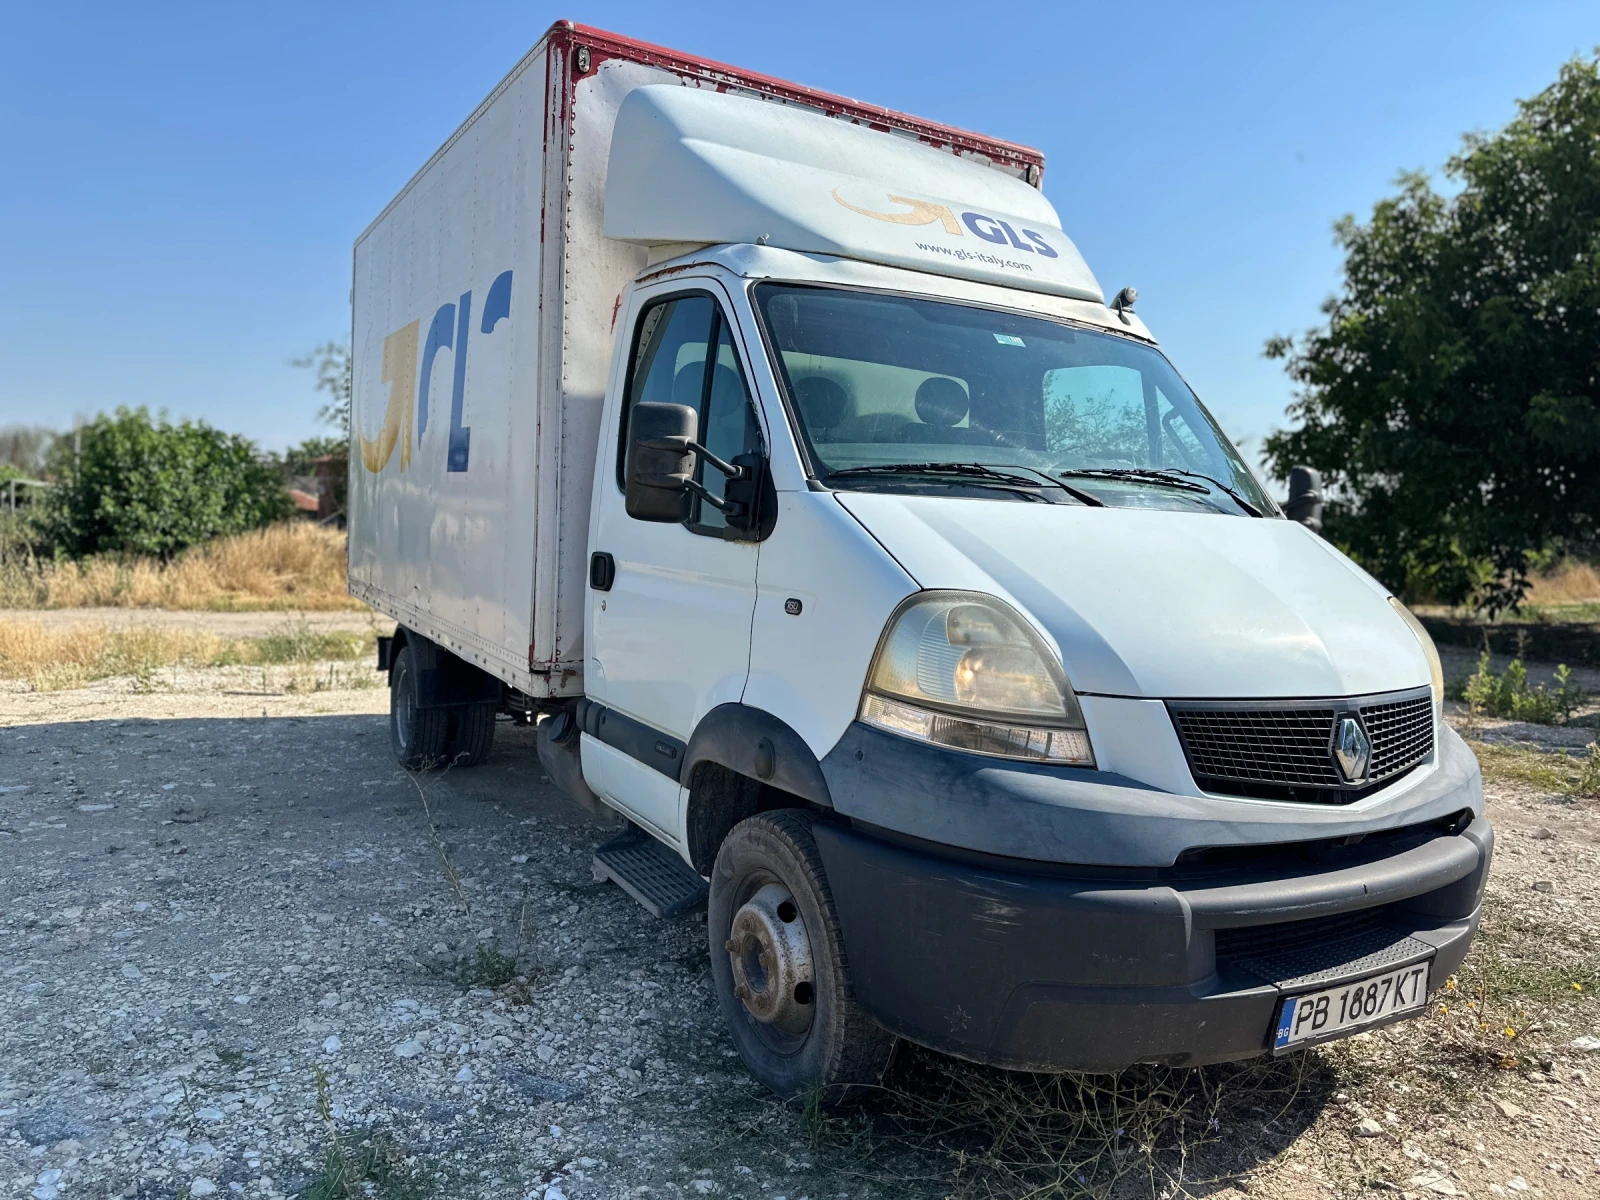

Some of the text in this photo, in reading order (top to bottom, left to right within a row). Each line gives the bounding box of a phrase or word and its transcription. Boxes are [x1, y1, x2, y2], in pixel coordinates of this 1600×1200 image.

[961, 211, 1059, 259] GLS
[915, 241, 1033, 271] www.gls-italy.com
[1277, 1026, 1289, 1039] BG
[1294, 995, 1330, 1035] PB
